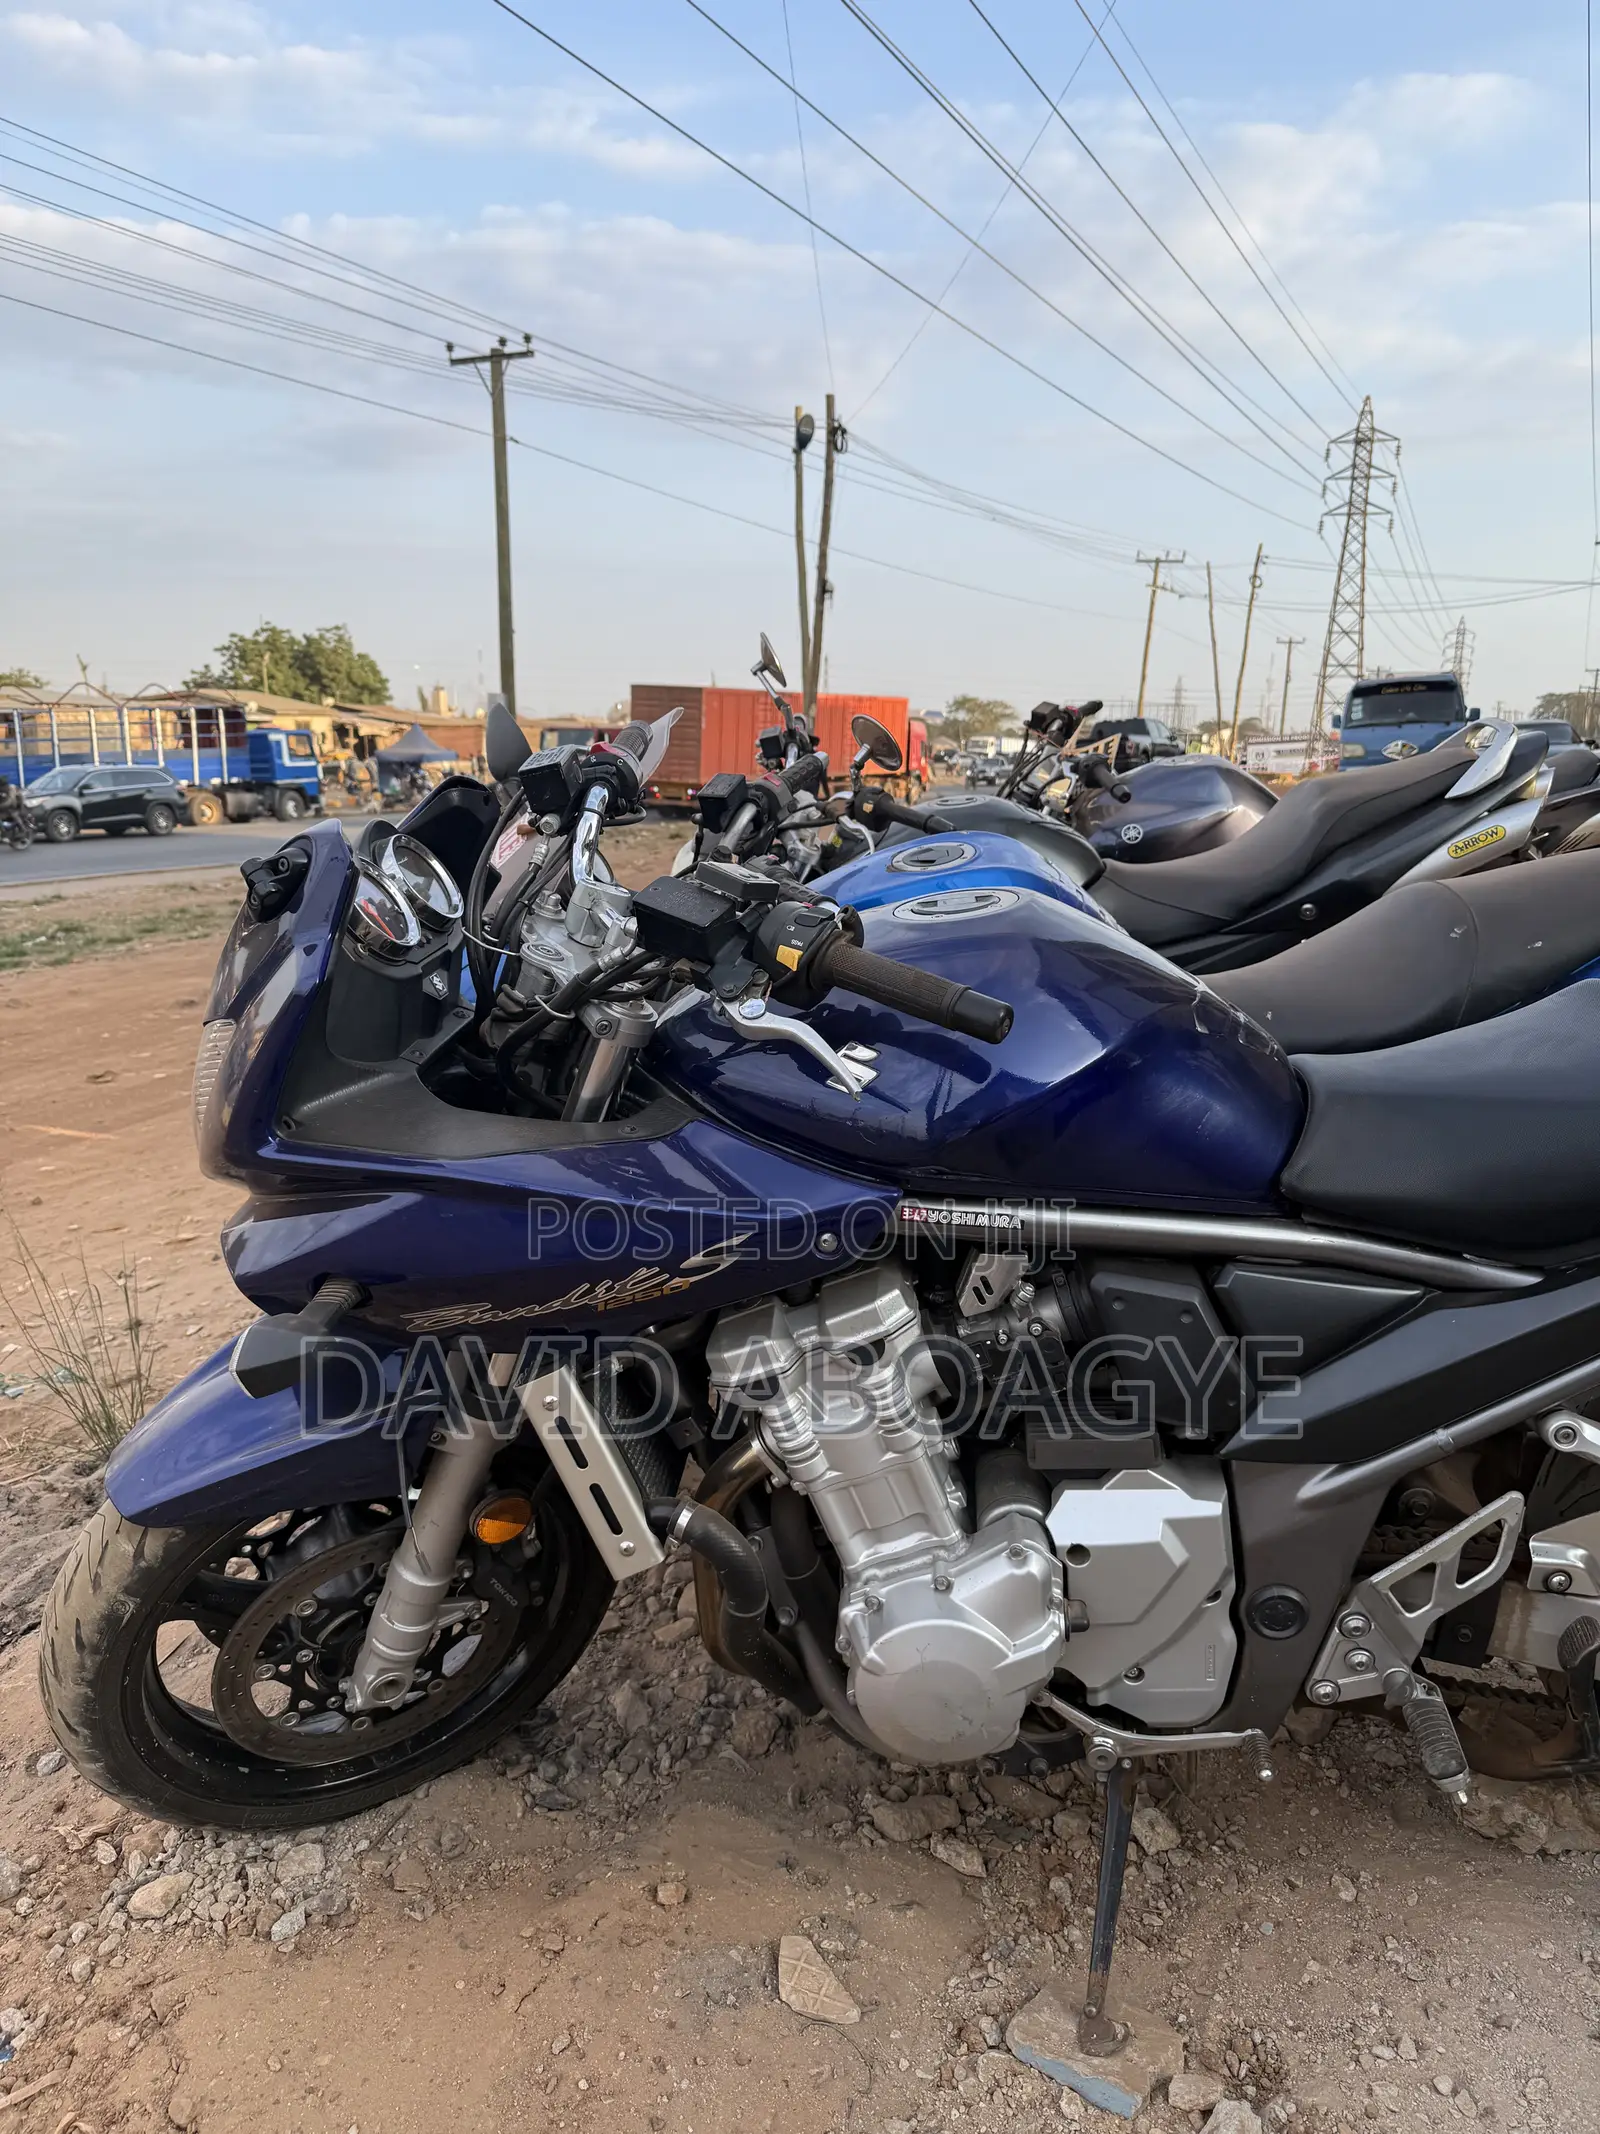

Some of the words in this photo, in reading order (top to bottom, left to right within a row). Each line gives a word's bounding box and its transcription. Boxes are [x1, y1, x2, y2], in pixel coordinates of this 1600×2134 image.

[1452, 827, 1499, 854] ARROW
[927, 1209, 1022, 1229] YOSHIMURA
[400, 1266, 670, 1333] Bandit
[597, 1280, 691, 1312] 1250
[490, 1577, 518, 1607] TOKICO
